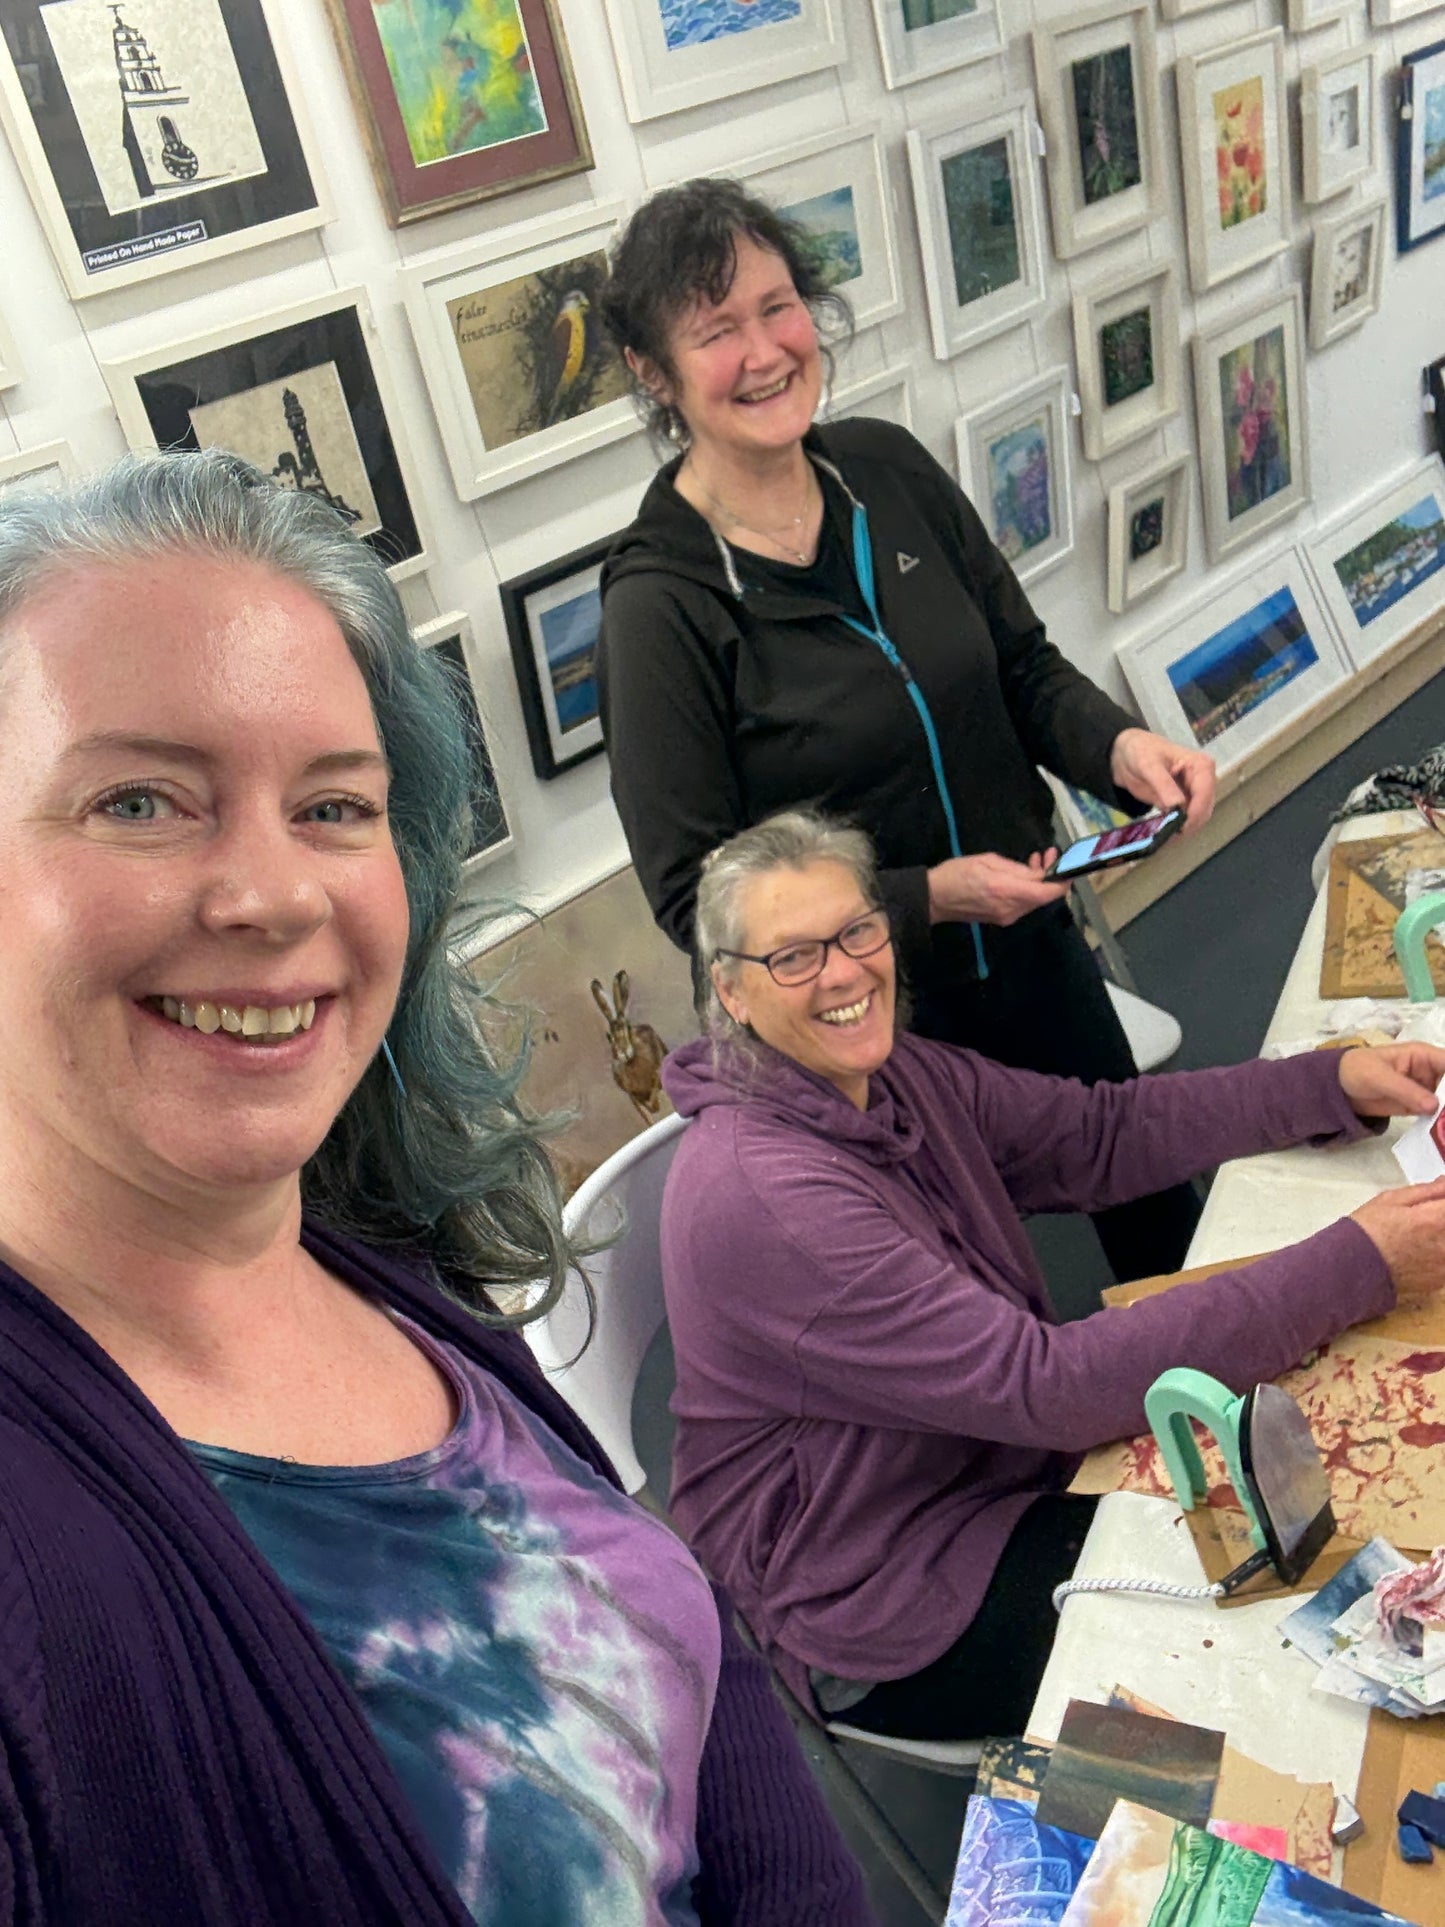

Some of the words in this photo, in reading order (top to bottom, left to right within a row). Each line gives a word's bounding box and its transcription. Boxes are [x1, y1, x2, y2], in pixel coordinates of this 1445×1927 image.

[88, 251, 118, 266] Printed
[119, 247, 131, 257] On
[132, 241, 154, 254] Hand
[155, 235, 175, 246] Made
[177, 228, 199, 240] Paper
